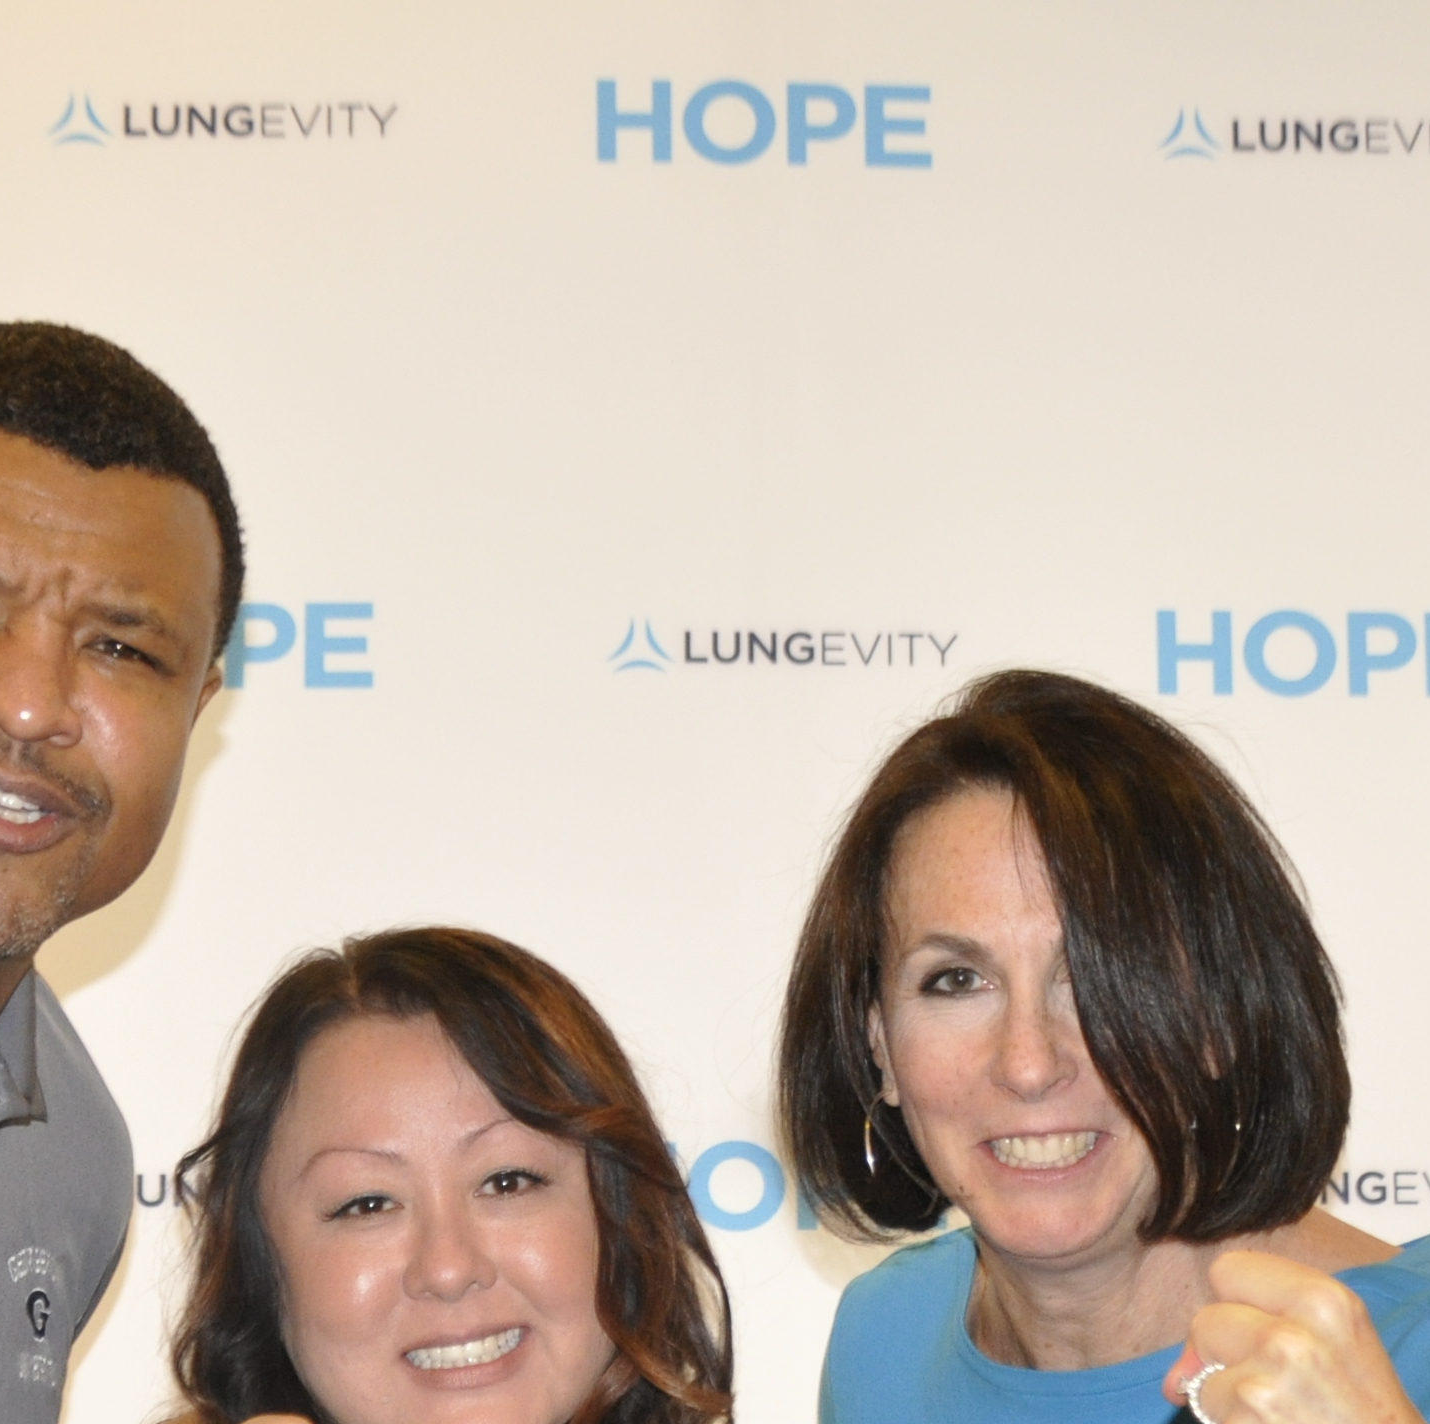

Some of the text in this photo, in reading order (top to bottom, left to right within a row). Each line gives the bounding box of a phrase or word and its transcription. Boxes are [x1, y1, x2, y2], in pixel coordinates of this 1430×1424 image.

[122, 102, 398, 140] LUNGEVITY
[595, 77, 934, 170] HOPE
[682, 627, 959, 667] LUNGEVITY
